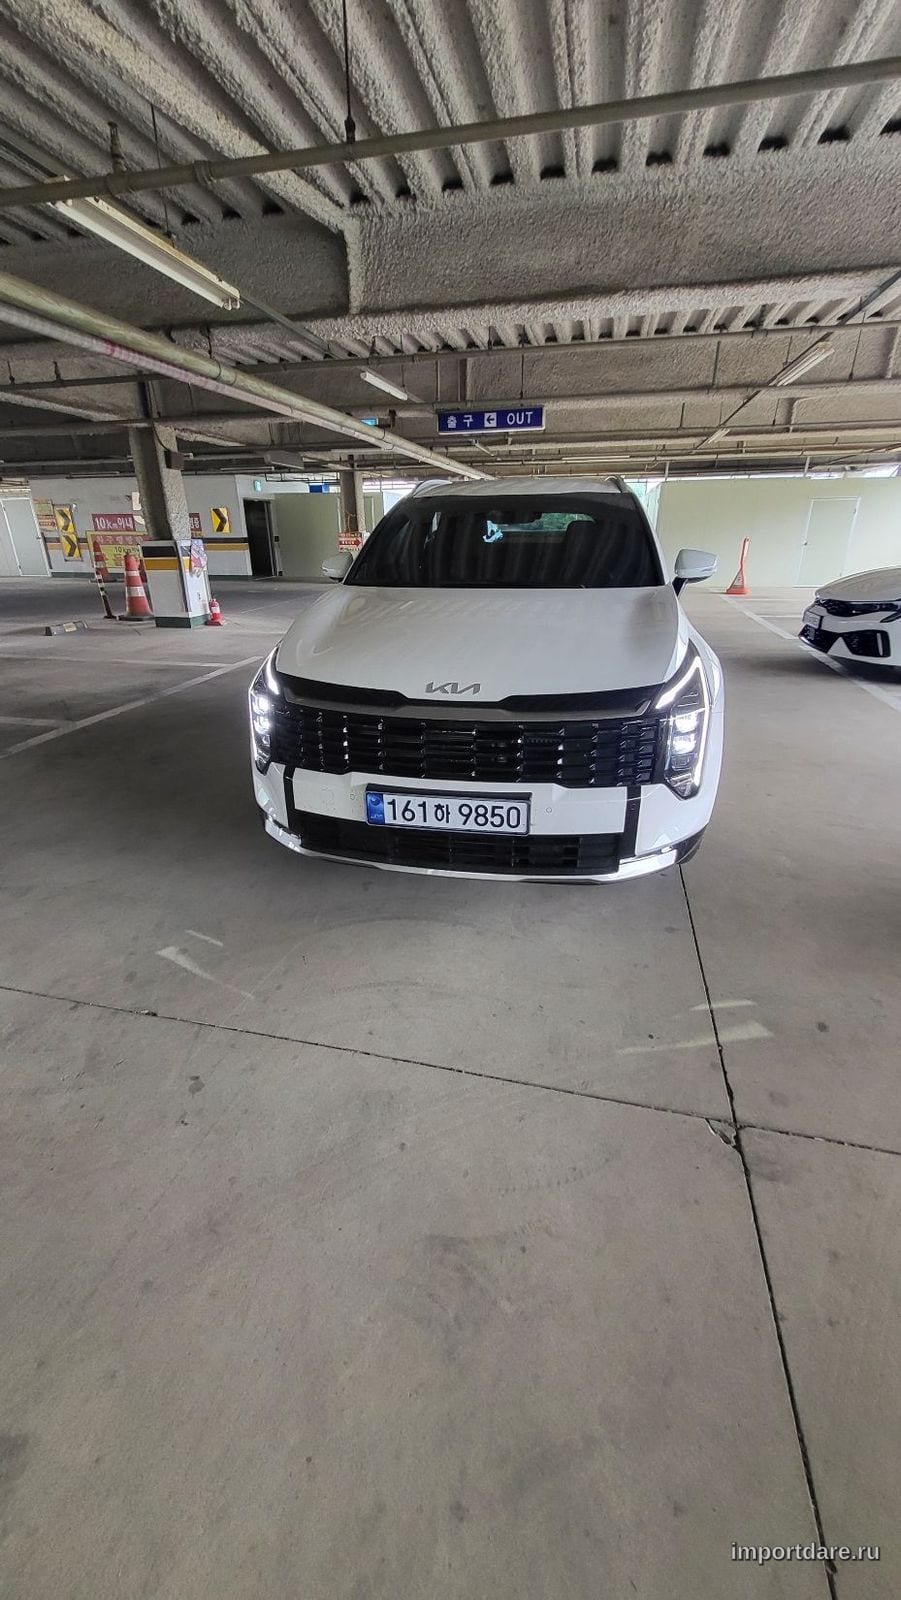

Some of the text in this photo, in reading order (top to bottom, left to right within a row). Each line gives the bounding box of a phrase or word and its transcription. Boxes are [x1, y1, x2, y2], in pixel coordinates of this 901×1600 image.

[506, 411, 533, 425] OUT
[425, 681, 481, 695] KIA
[387, 798, 521, 829] 161하 9850
